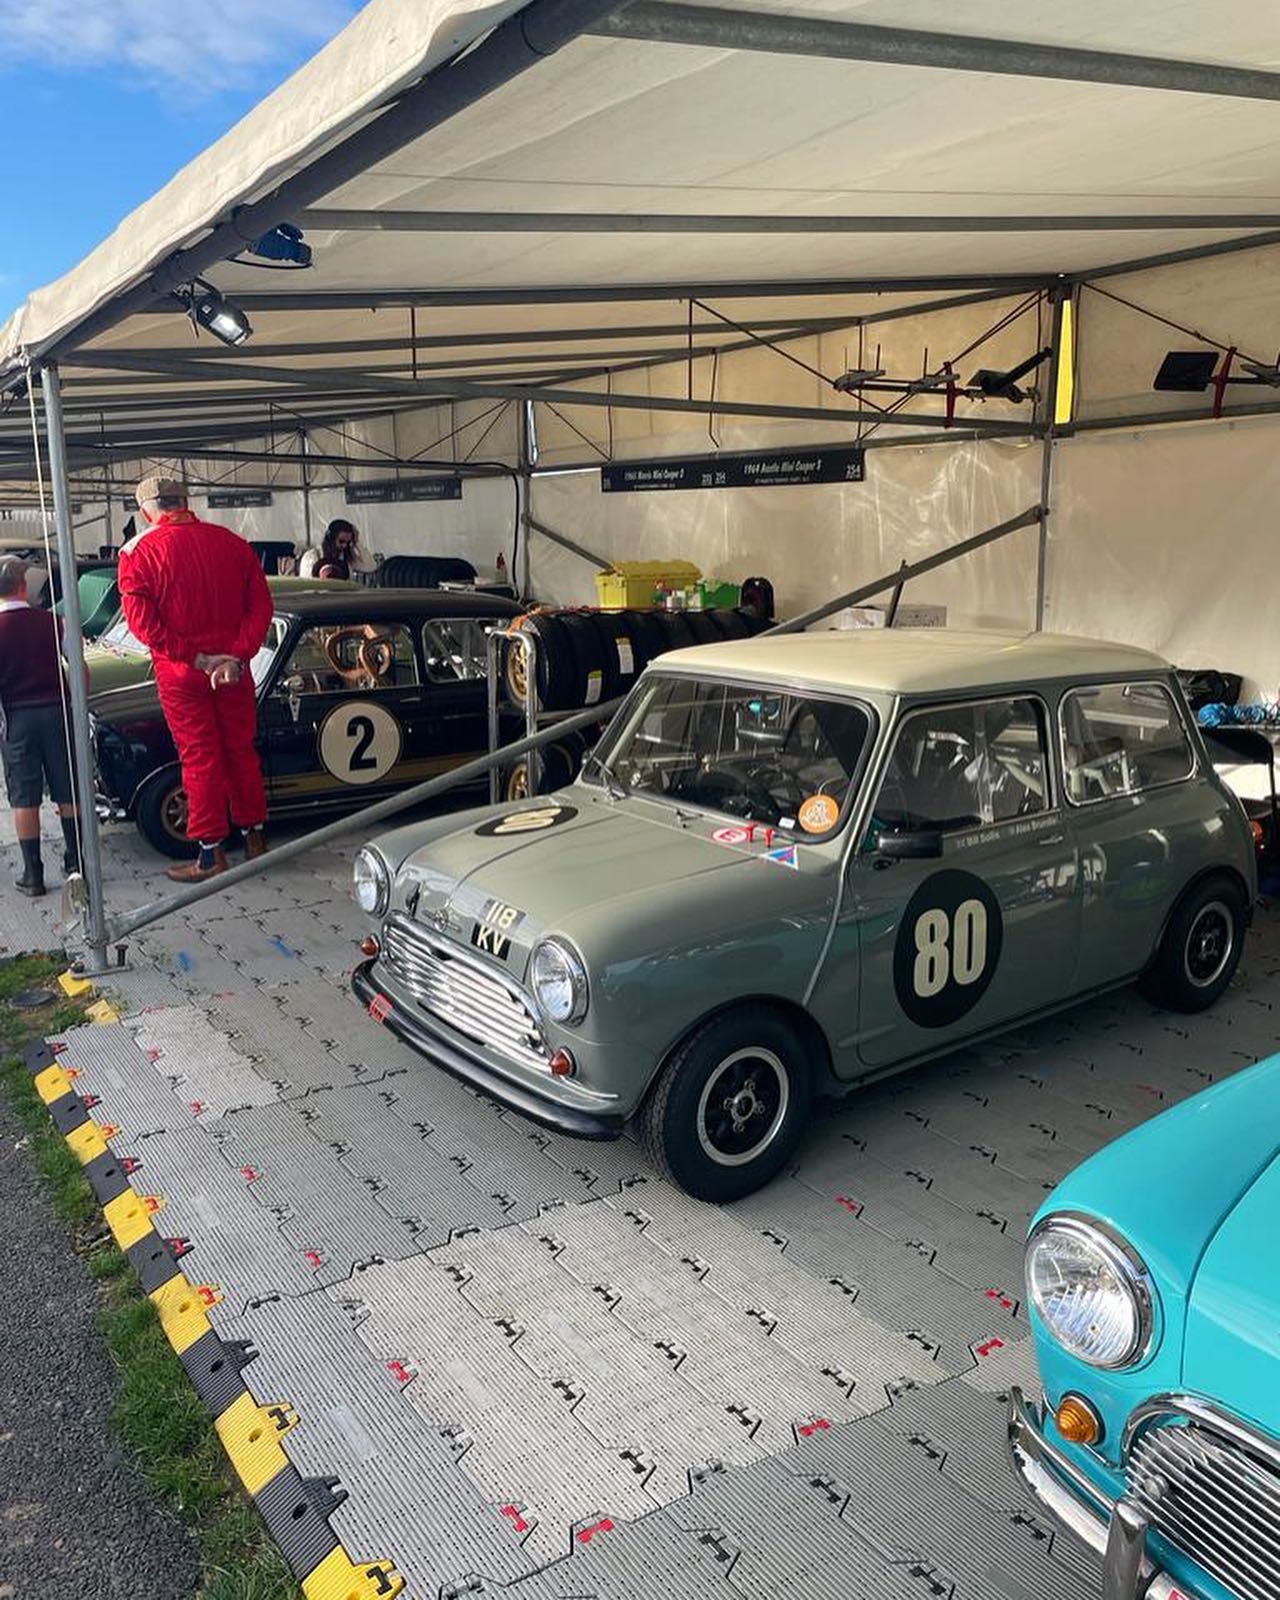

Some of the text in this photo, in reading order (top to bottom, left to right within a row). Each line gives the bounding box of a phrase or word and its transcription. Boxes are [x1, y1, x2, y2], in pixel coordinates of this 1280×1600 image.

[347, 715, 378, 771] 2
[486, 901, 517, 928] 118
[476, 924, 506, 955] KV
[913, 899, 987, 998] 80
